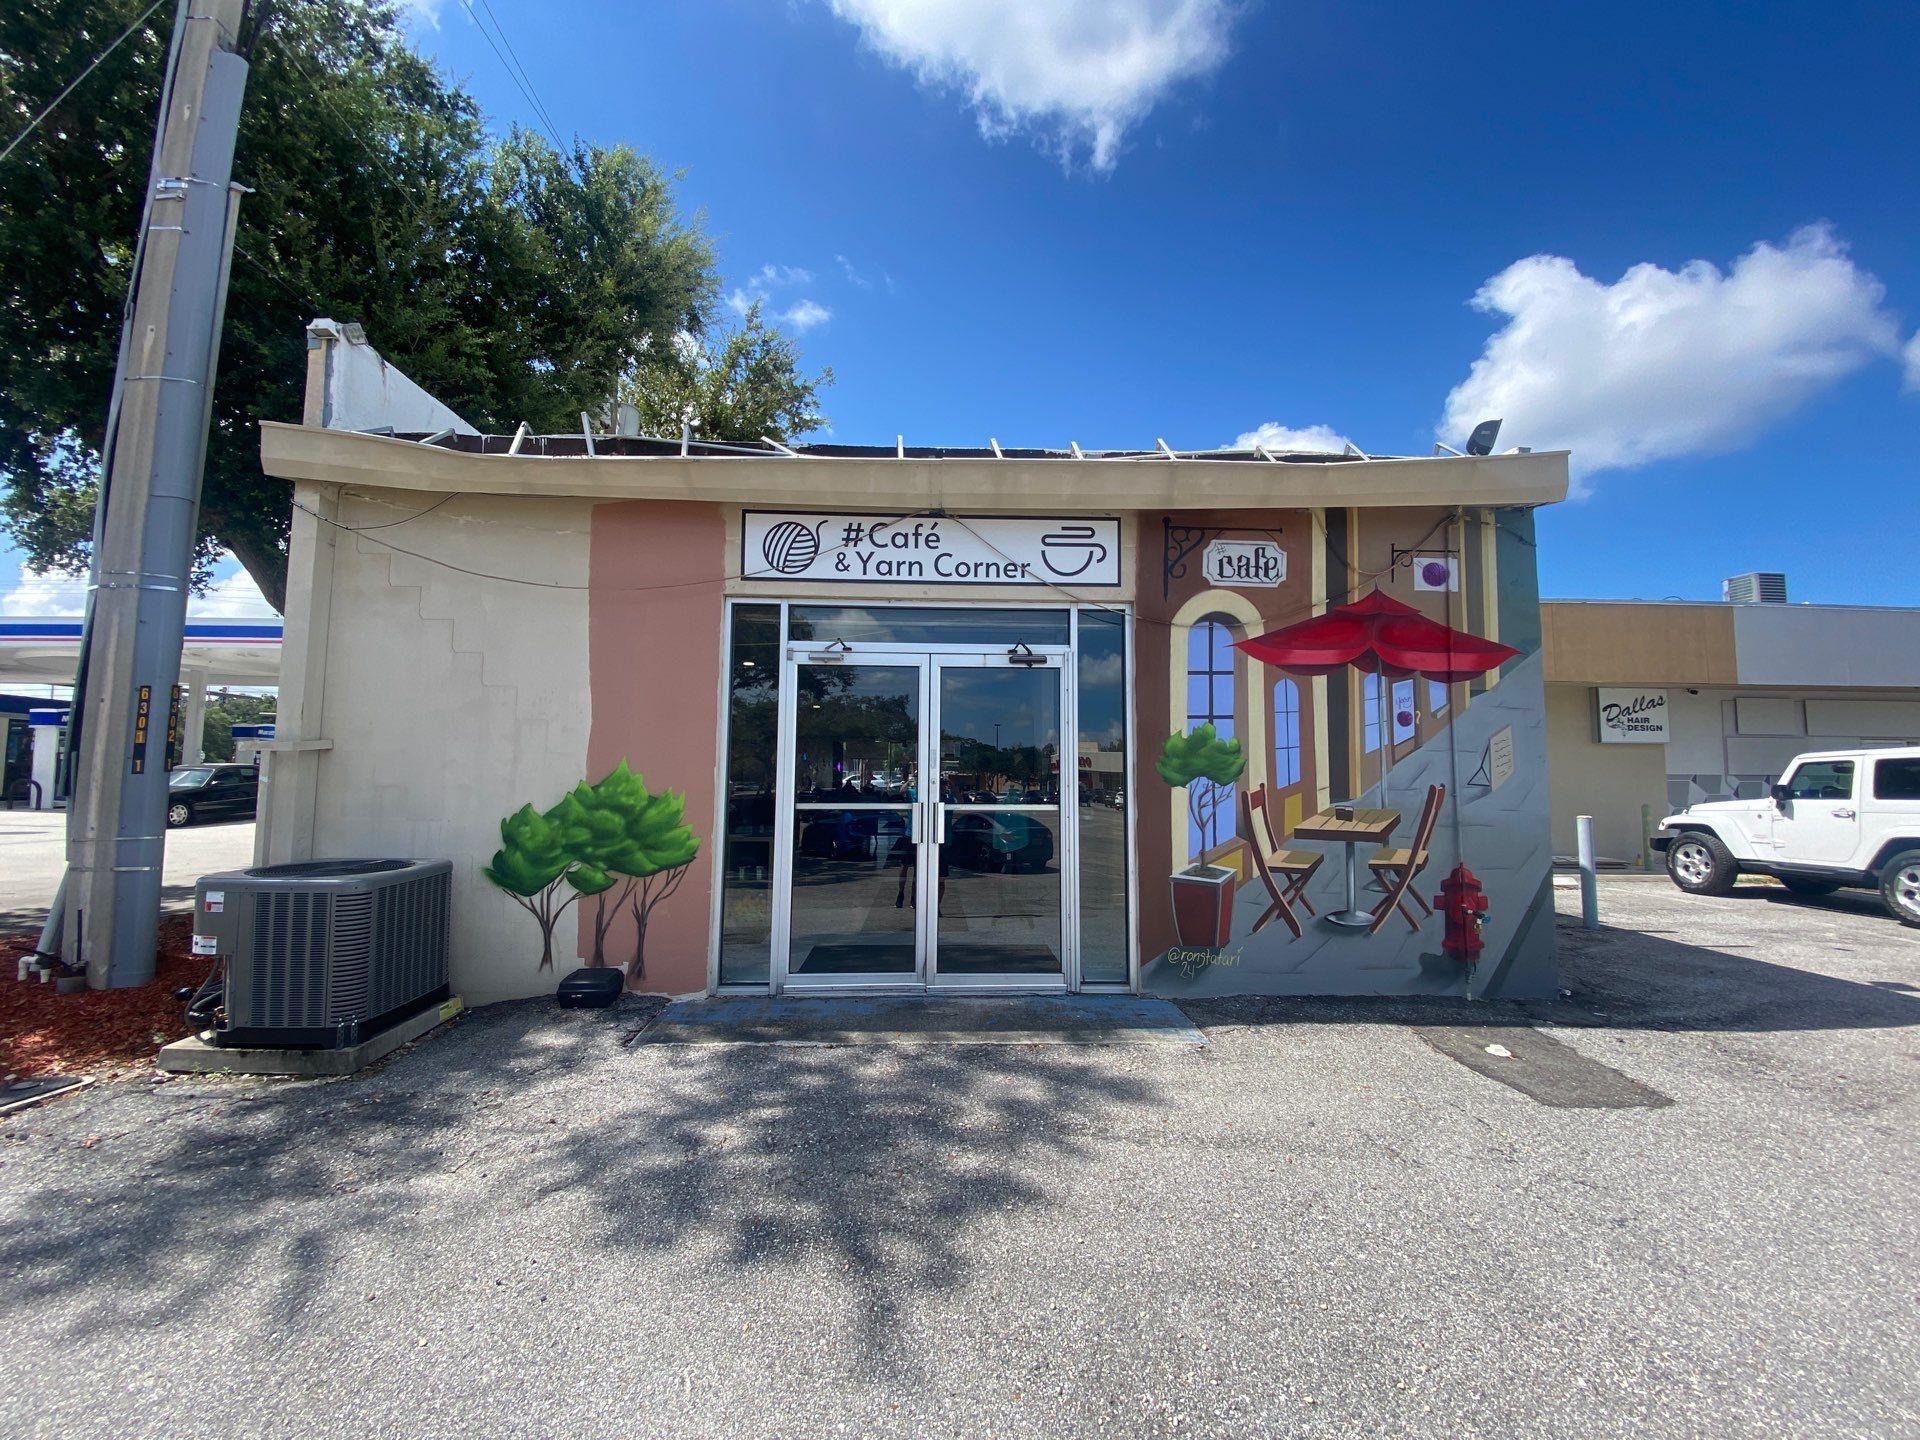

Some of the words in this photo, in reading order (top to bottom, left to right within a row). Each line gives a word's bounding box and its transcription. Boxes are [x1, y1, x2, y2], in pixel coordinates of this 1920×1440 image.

[841, 521, 941, 550] #Café
[933, 552, 1031, 579] Corner
[1602, 695, 1666, 723] Dallas
[1627, 724, 1663, 732] DESIGN
[1180, 961, 1195, 980] 24
